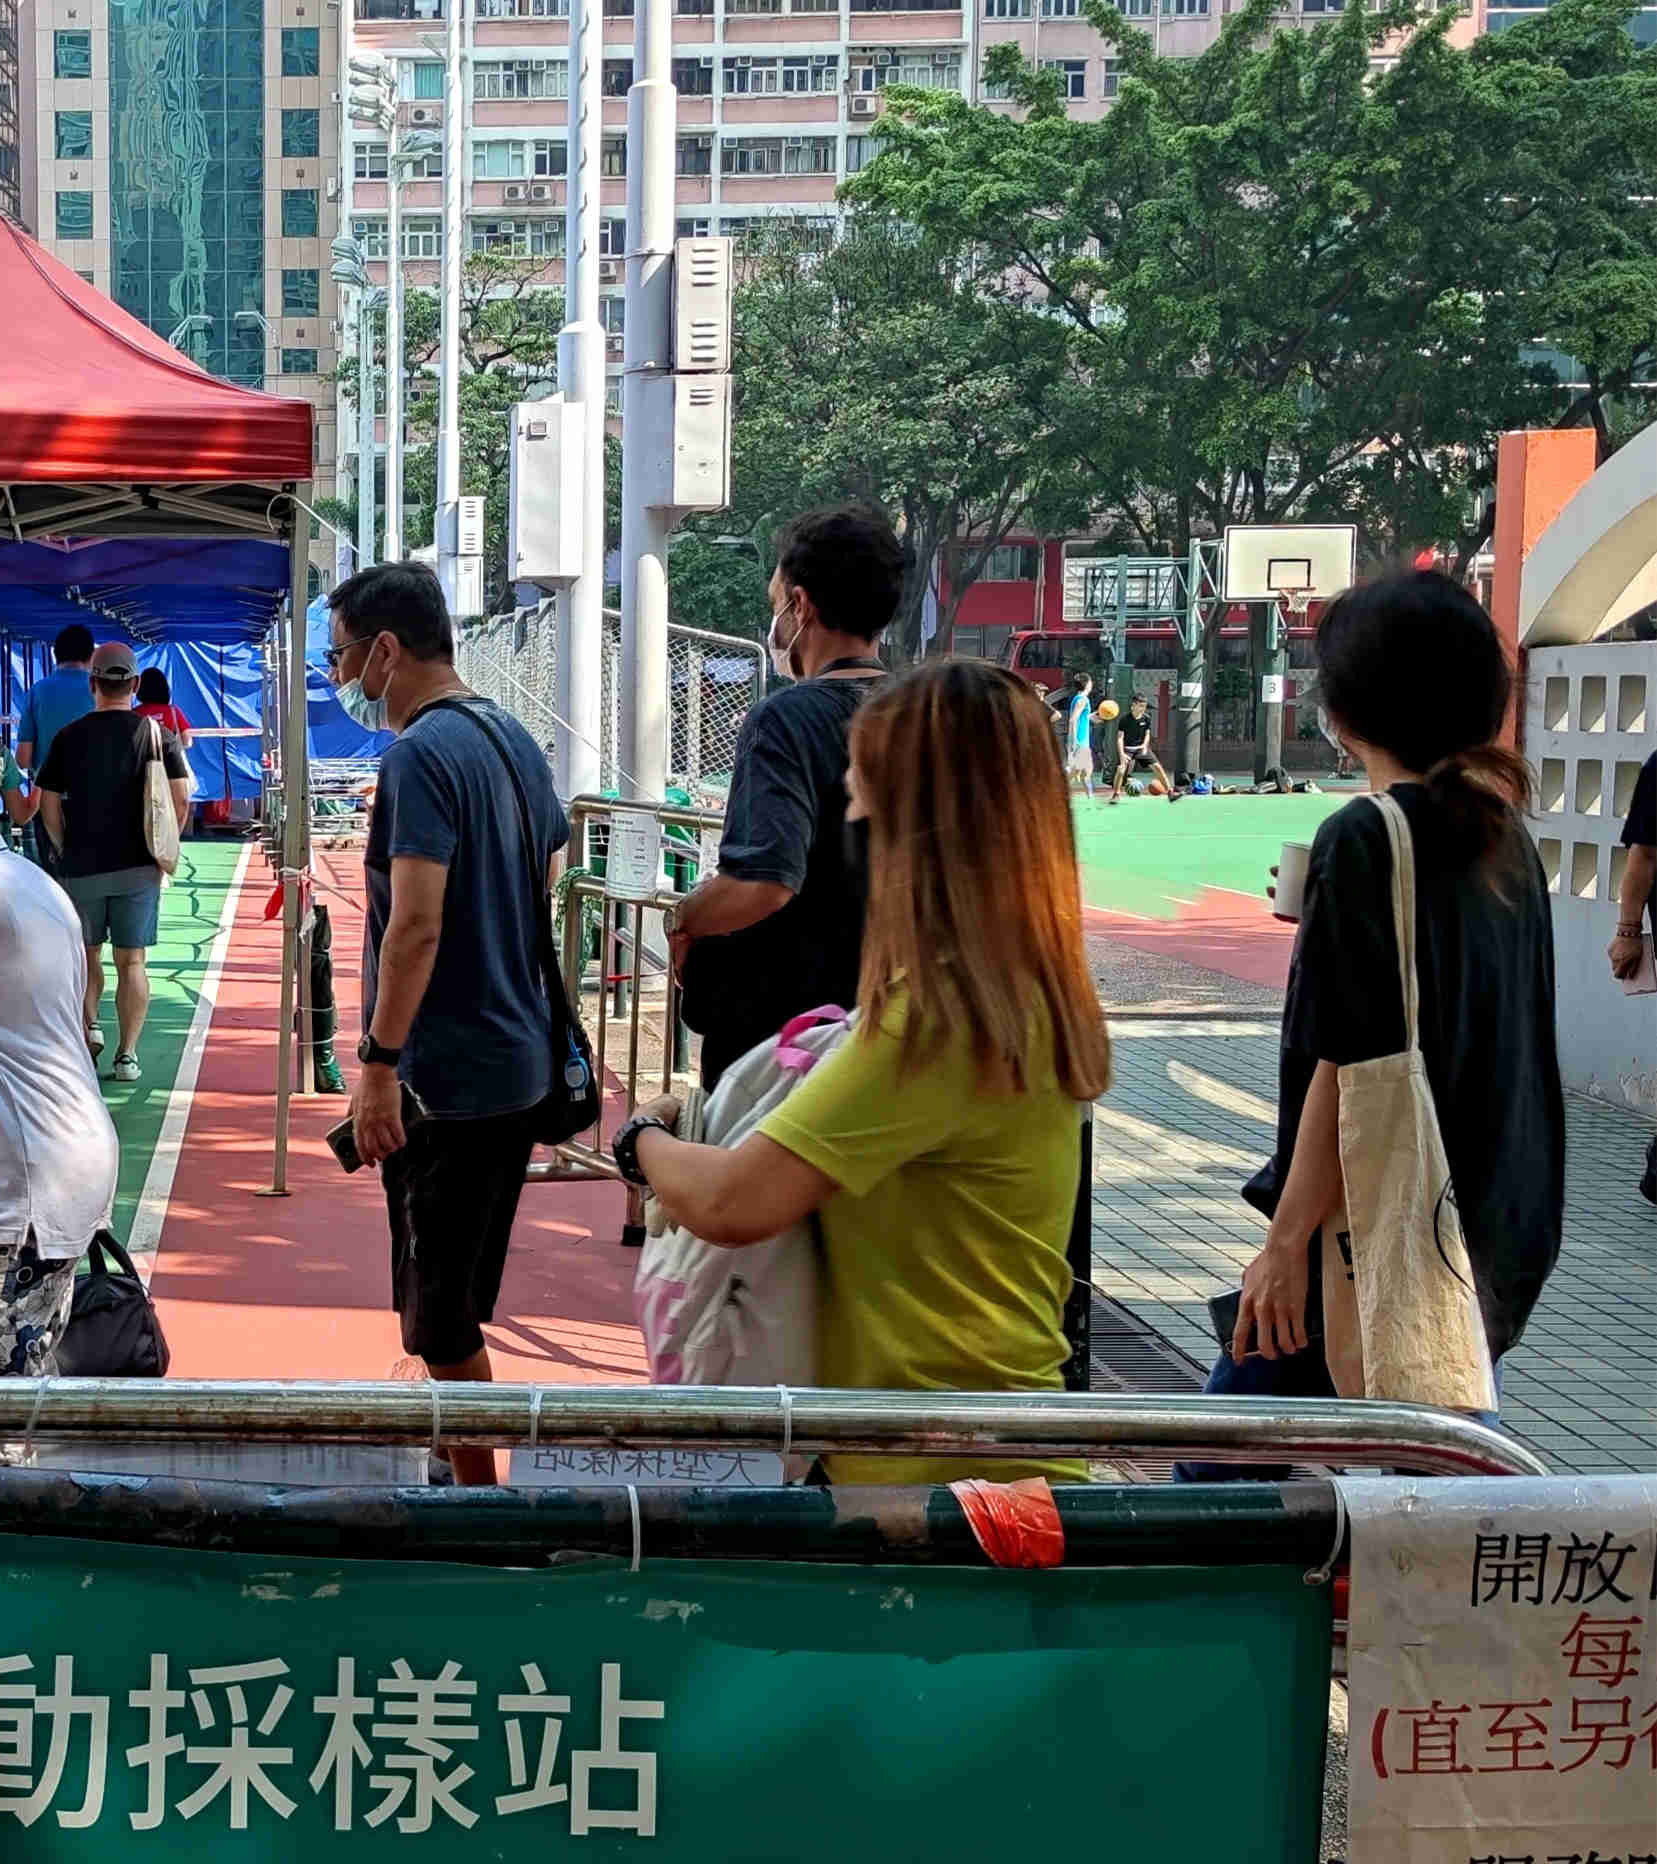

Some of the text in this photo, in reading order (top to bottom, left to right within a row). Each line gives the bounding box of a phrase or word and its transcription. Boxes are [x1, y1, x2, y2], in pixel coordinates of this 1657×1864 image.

[1471, 1529, 1657, 1607] 開放
[1371, 1696, 1657, 1779] (直至另
